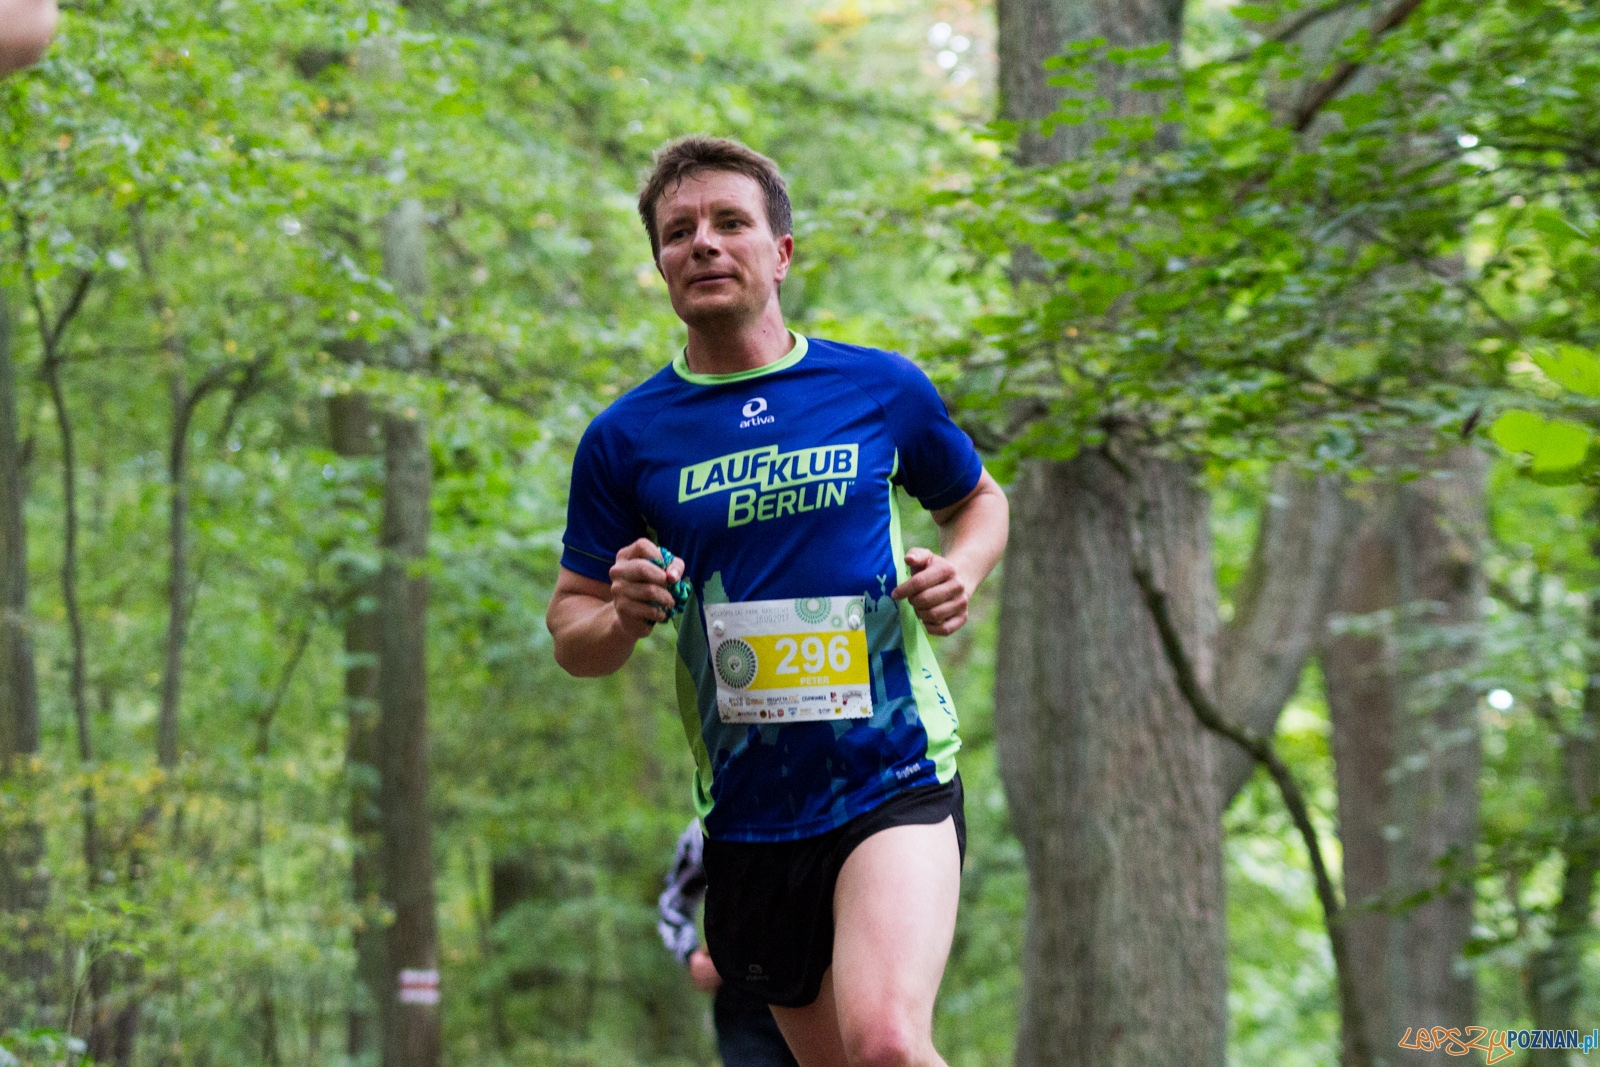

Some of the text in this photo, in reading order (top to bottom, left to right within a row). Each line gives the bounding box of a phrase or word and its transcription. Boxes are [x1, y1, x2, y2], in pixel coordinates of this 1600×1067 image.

[739, 414, 775, 428] artiva
[727, 481, 847, 528] BERLIN
[775, 635, 851, 675] 296
[800, 675, 830, 685] PETER
